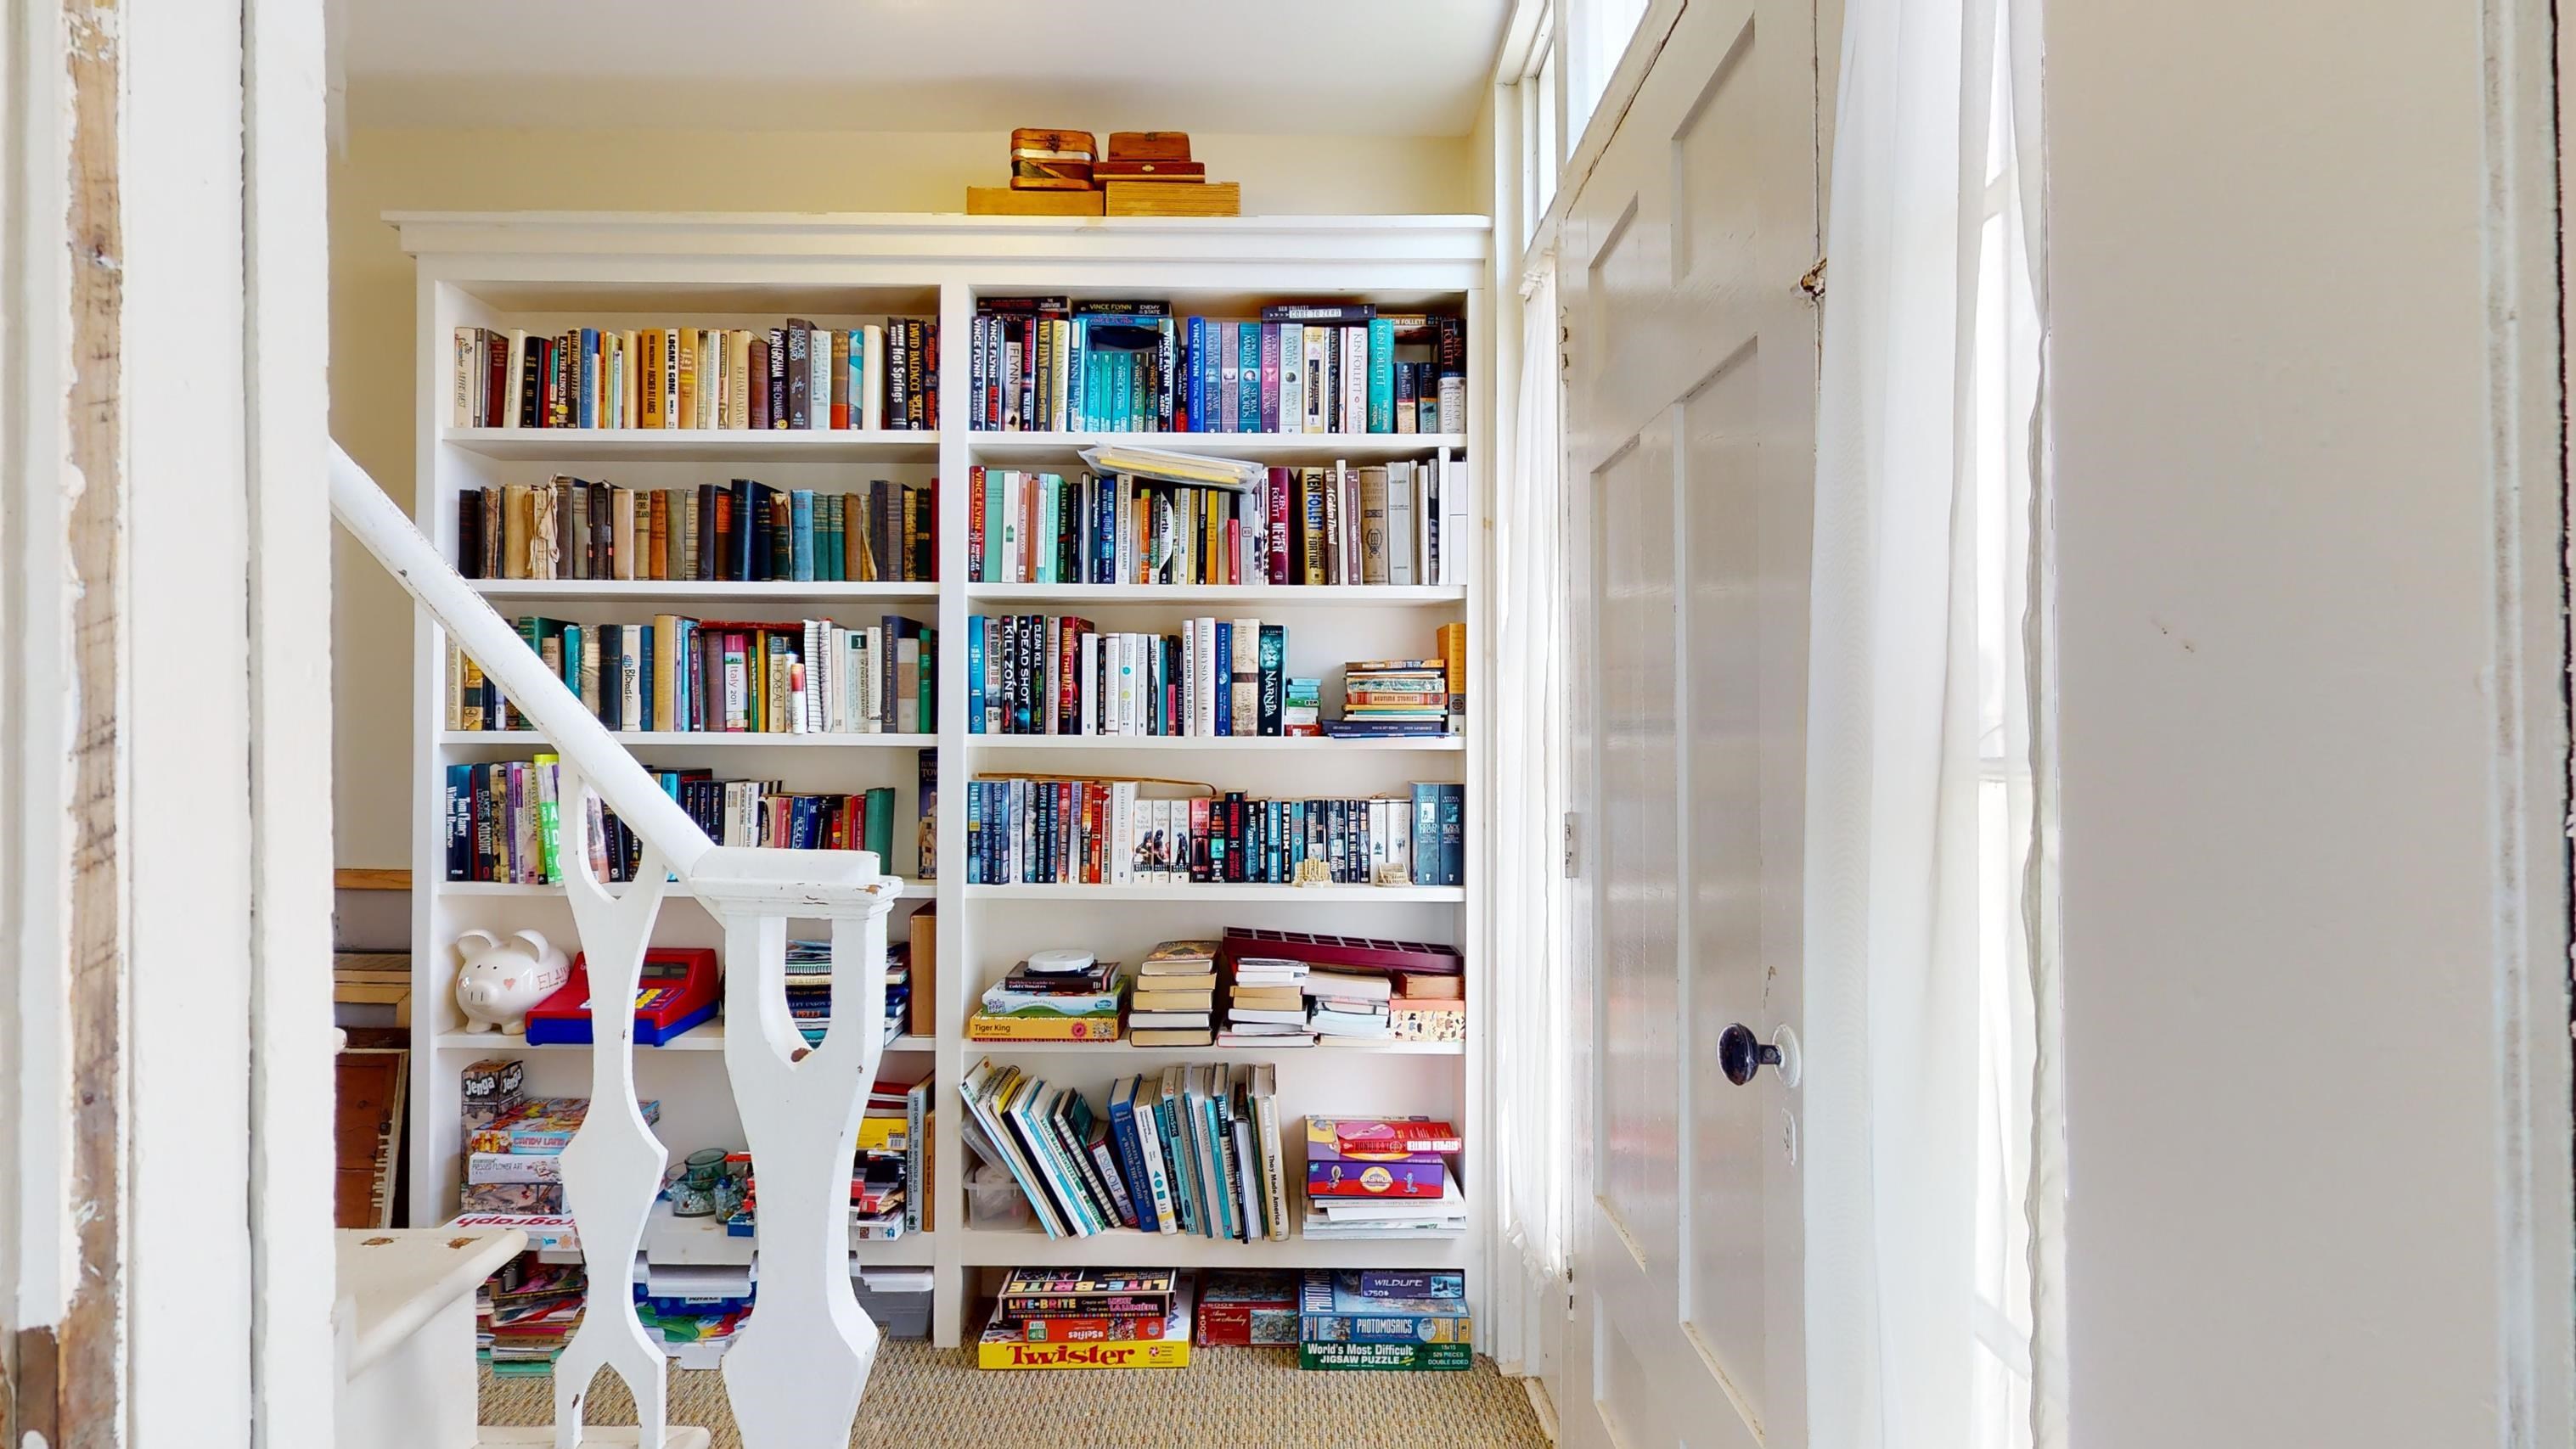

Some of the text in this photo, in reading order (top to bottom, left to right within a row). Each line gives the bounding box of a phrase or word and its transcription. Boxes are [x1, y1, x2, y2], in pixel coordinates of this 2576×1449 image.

[797, 329, 806, 359] ELMORE
[909, 323, 920, 391] DAVID BALDACCI
[973, 319, 981, 377] VINCE FLYNN
[1376, 325, 1386, 386] KEN FOLLETT
[1443, 329, 1453, 366] FOLLETT
[1454, 338, 1462, 357] KEN
[772, 348, 785, 377] GRISHAM
[891, 348, 905, 402] Hot Springs
[1010, 348, 1019, 385] FLYNN
[1353, 334, 1363, 394] KEN FOLLETT
[647, 370, 656, 390] ARCHER
[647, 398, 655, 413] LARGE
[736, 366, 745, 426] RICHARD ADAMS
[773, 380, 784, 419] THE CHAMBER
[914, 395, 922, 419] SPLIT
[988, 386, 998, 422] KILL SHOT
[1444, 391, 1454, 427] ETERNITY
[1307, 474, 1323, 530] KEN FOLLETT
[1272, 522, 1285, 553] NEVER
[1308, 536, 1318, 569] FORTUNE
[855, 637, 863, 648] 1
[1063, 627, 1072, 655] RUNNING
[728, 666, 742, 688] Italy
[772, 658, 784, 708] THOREAU
[1062, 674, 1071, 691] MAZE
[1263, 670, 1277, 717] NARNIA
[447, 786, 457, 815] Without
[550, 806, 558, 822] A
[454, 797, 470, 837] Tom Clancy
[478, 822, 492, 855] KILLSHOT
[553, 830, 559, 845] D
[465, 1076, 495, 1096] Jenga
[503, 1068, 522, 1092] Jenga
[1166, 1100, 1179, 1137] GREENSPEC
[514, 1137, 542, 1146] CANDY
[1127, 1132, 1140, 1160] COMPLETE
[1134, 1160, 1145, 1177] TALES
[514, 1162, 523, 1171] ART
[1105, 1167, 1122, 1193] GOLF
[1122, 1142, 1145, 1199] WINNIE-THE-POOH
[1268, 1154, 1276, 1172] They
[1272, 1196, 1281, 1226] America
[457, 1216, 576, 1228] rograph
[1008, 1279, 1169, 1292] LITE-BRITE
[1009, 1298, 1076, 1309] LITE-BRITE
[1357, 1318, 1412, 1334] PHOTOMOSAICS
[1006, 1344, 1135, 1365] Twister
[1308, 1343, 1414, 1356] World's Most Difficult
[1320, 1356, 1399, 1364] JIGSAW PUZZLE
